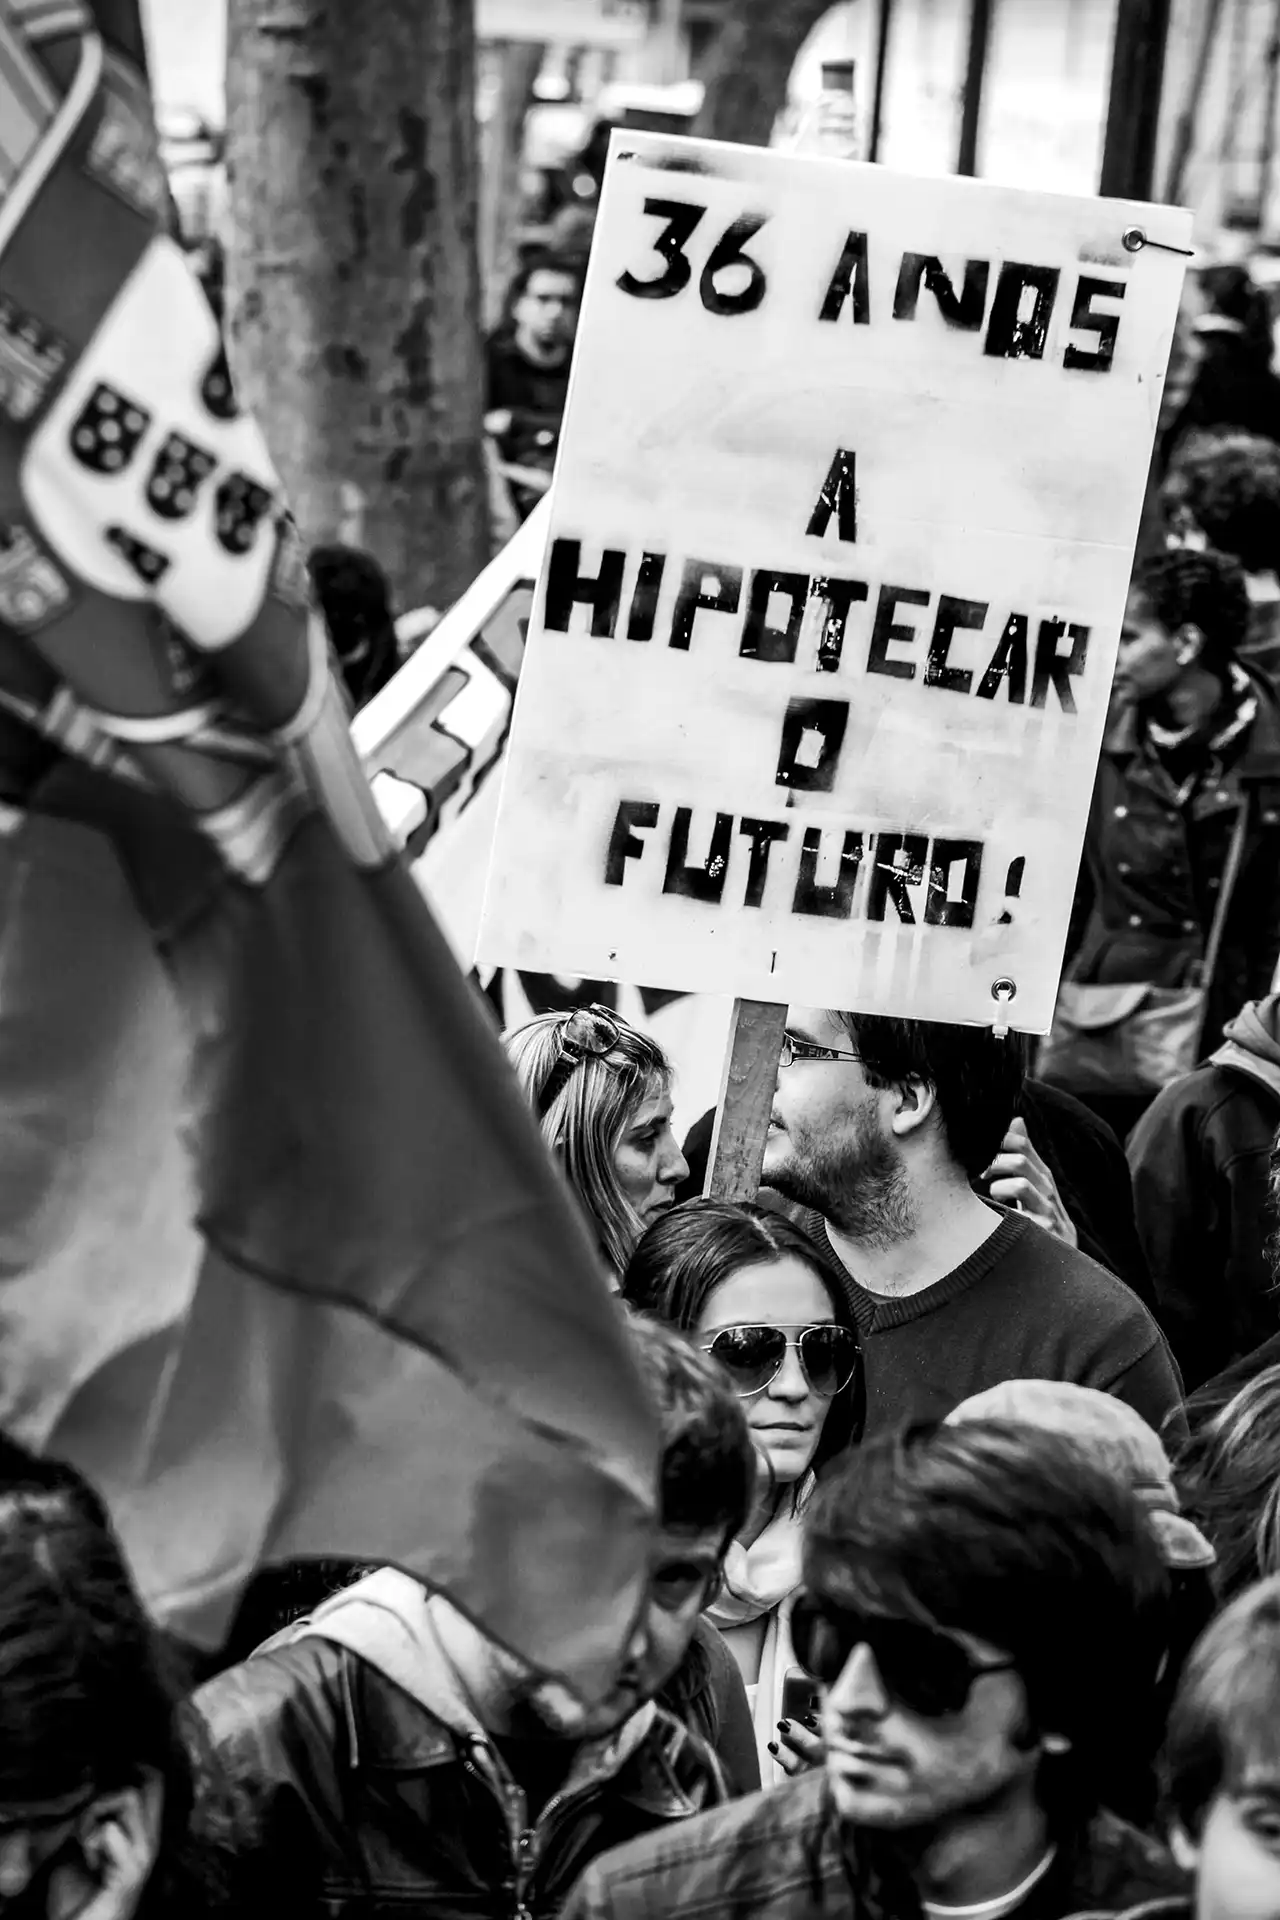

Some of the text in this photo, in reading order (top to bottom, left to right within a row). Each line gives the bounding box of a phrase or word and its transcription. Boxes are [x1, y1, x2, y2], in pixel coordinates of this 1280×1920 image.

[615, 197, 1127, 373] 36 ANOS
[805, 447, 857, 544] A
[543, 537, 1092, 712] HIPOTECAR
[774, 697, 850, 793] O
[604, 799, 1026, 930] FUTURO!
